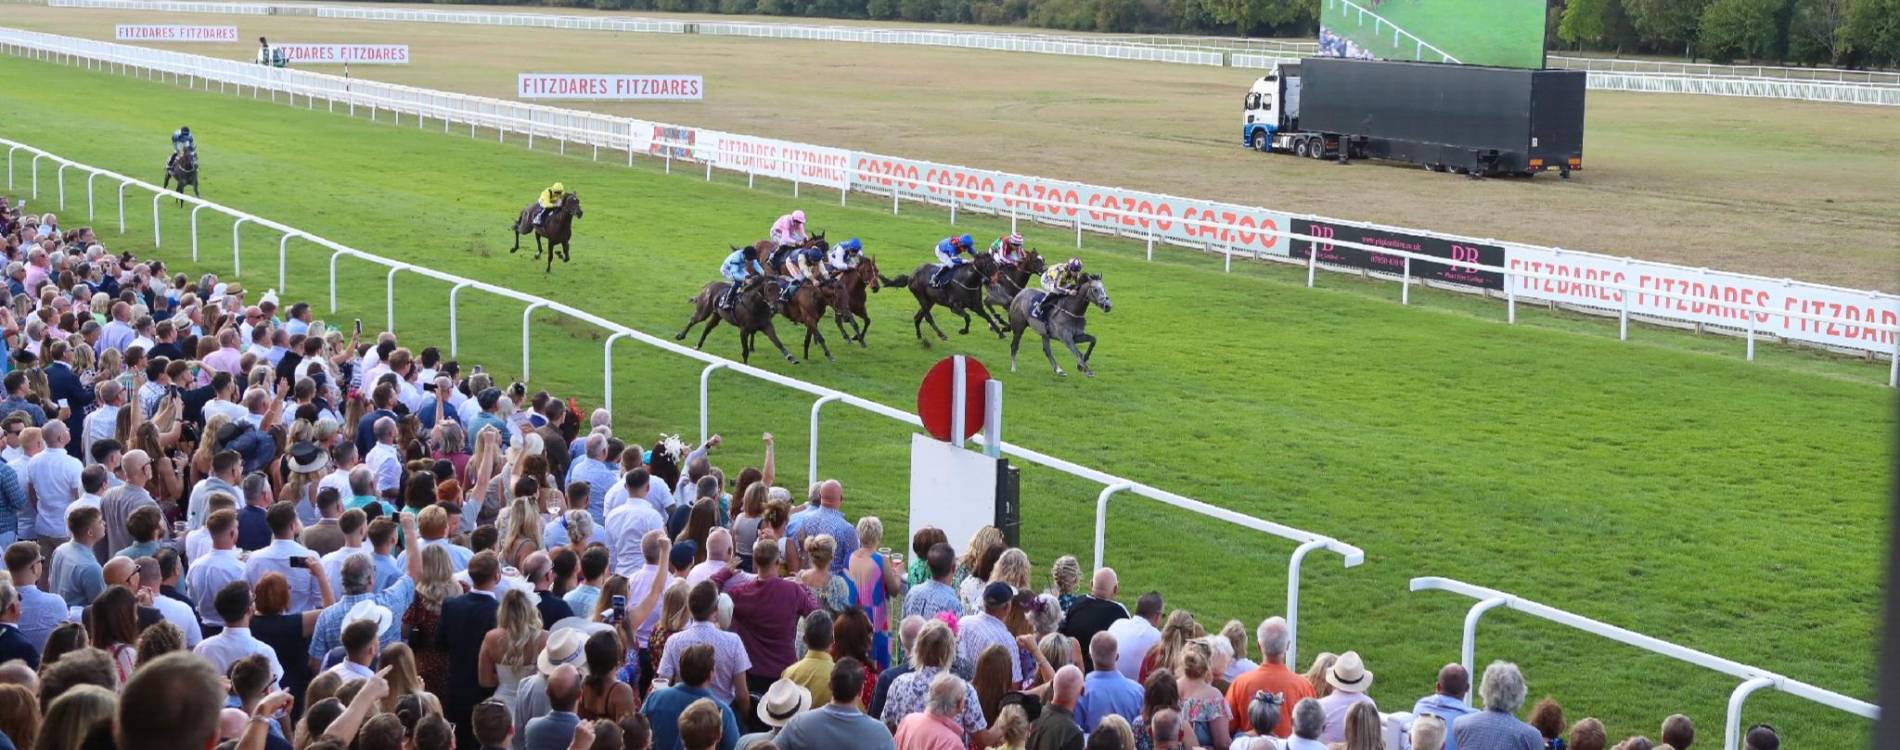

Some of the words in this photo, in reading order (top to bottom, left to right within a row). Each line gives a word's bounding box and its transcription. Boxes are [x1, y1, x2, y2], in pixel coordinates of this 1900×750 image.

[119, 27, 175, 38] FITZDARES
[180, 27, 235, 39] FITZDARES
[281, 47, 334, 60] TZDARES
[340, 47, 405, 60] FITZDARES
[523, 78, 607, 94] FITZDARES
[616, 79, 698, 96] FITZDARES
[718, 138, 776, 169] FITZDARES
[857, 158, 919, 190] CAZOO
[926, 168, 995, 203] CAZOO
[1002, 181, 1079, 216] CAZOO
[1088, 193, 1173, 231] CAZOO
[1183, 207, 1278, 248] CAZOO
[1450, 244, 1479, 273] PB
[1638, 274, 1770, 323] FITZDARES
